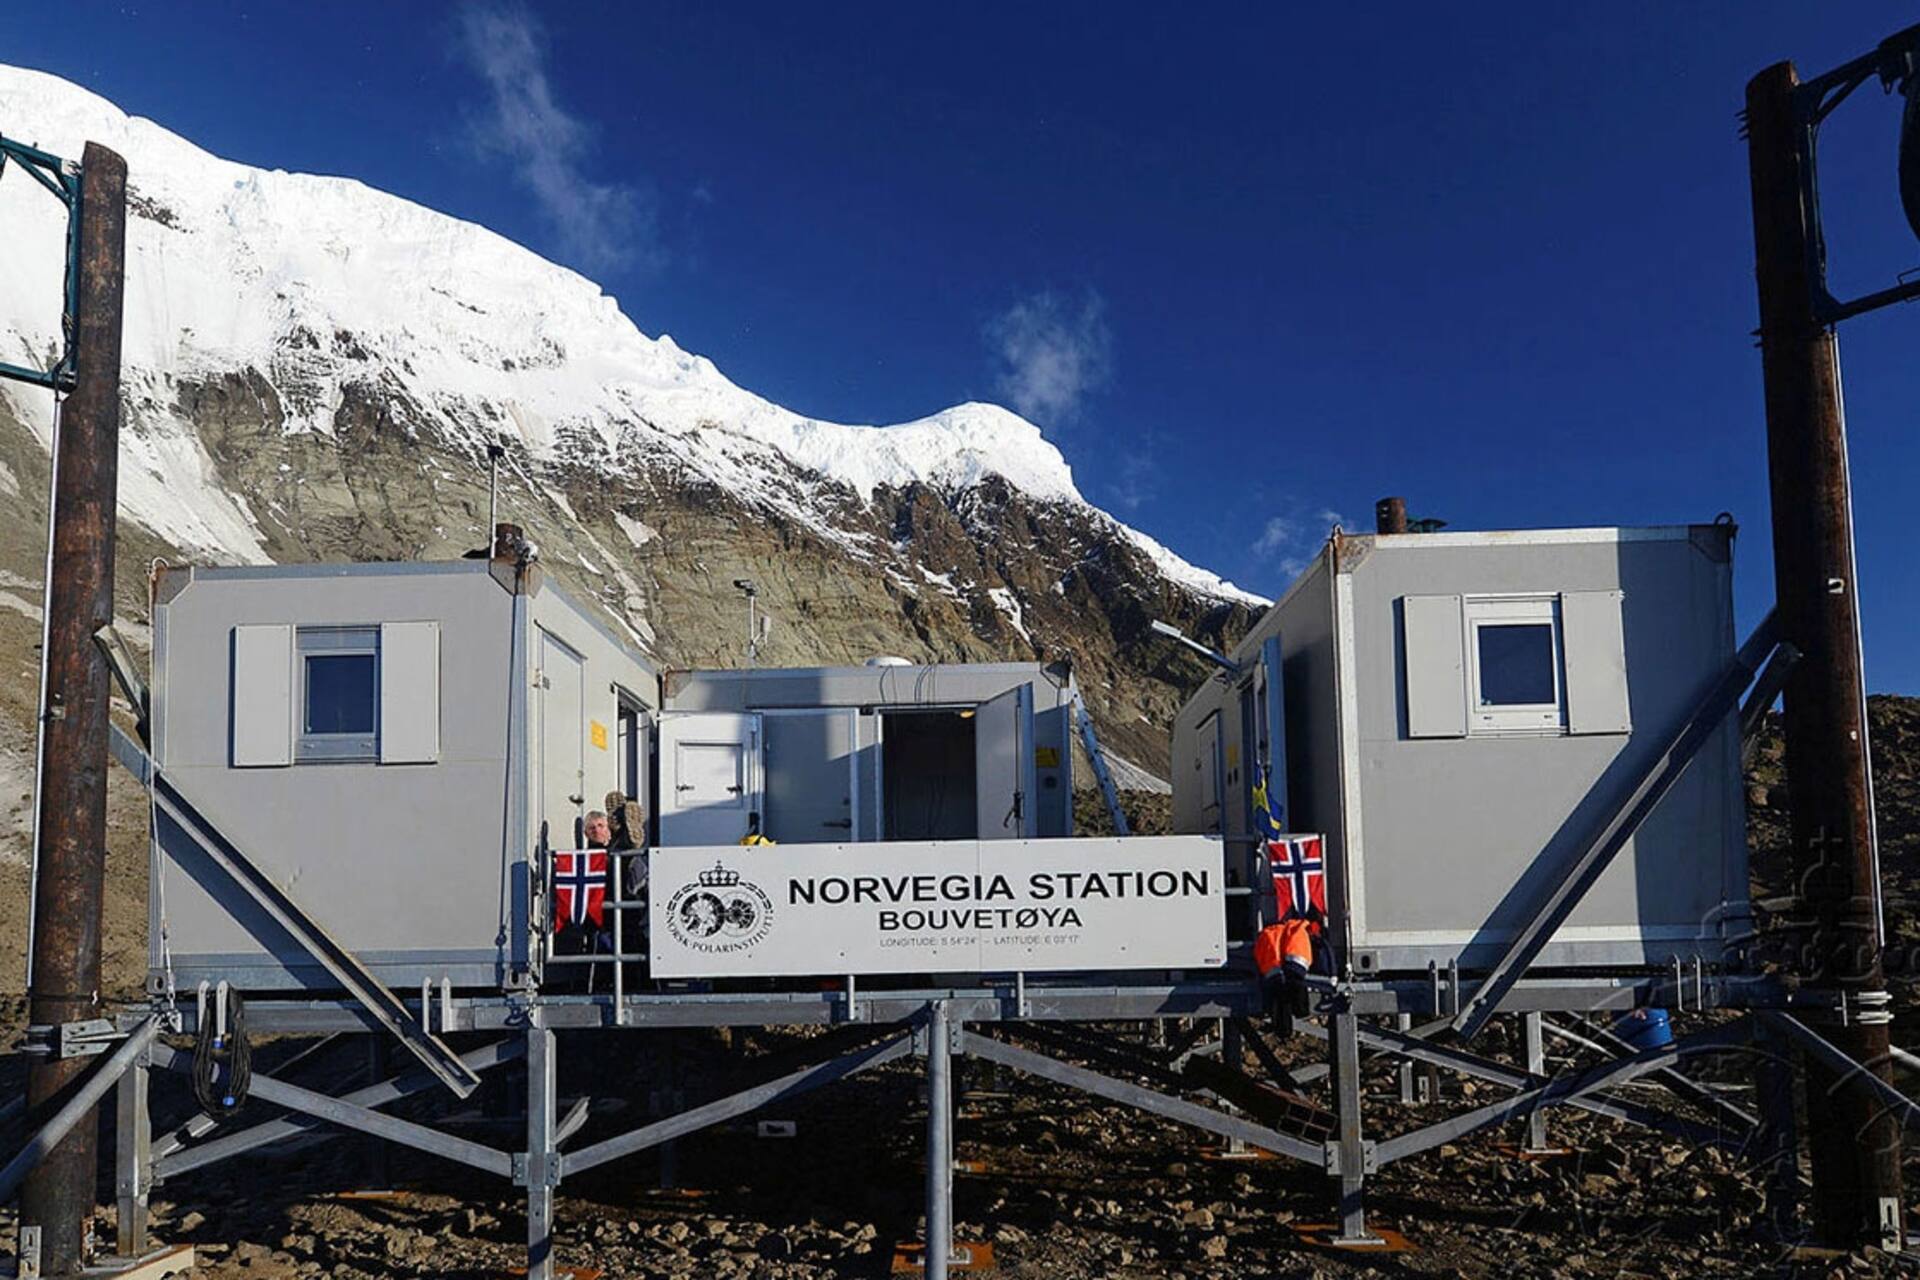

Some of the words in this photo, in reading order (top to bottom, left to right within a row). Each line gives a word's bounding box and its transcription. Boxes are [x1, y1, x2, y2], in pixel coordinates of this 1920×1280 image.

[789, 874, 1016, 905] NORVEGIA
[1028, 870, 1209, 900] STATION
[879, 907, 1083, 931] BOUVETØYA
